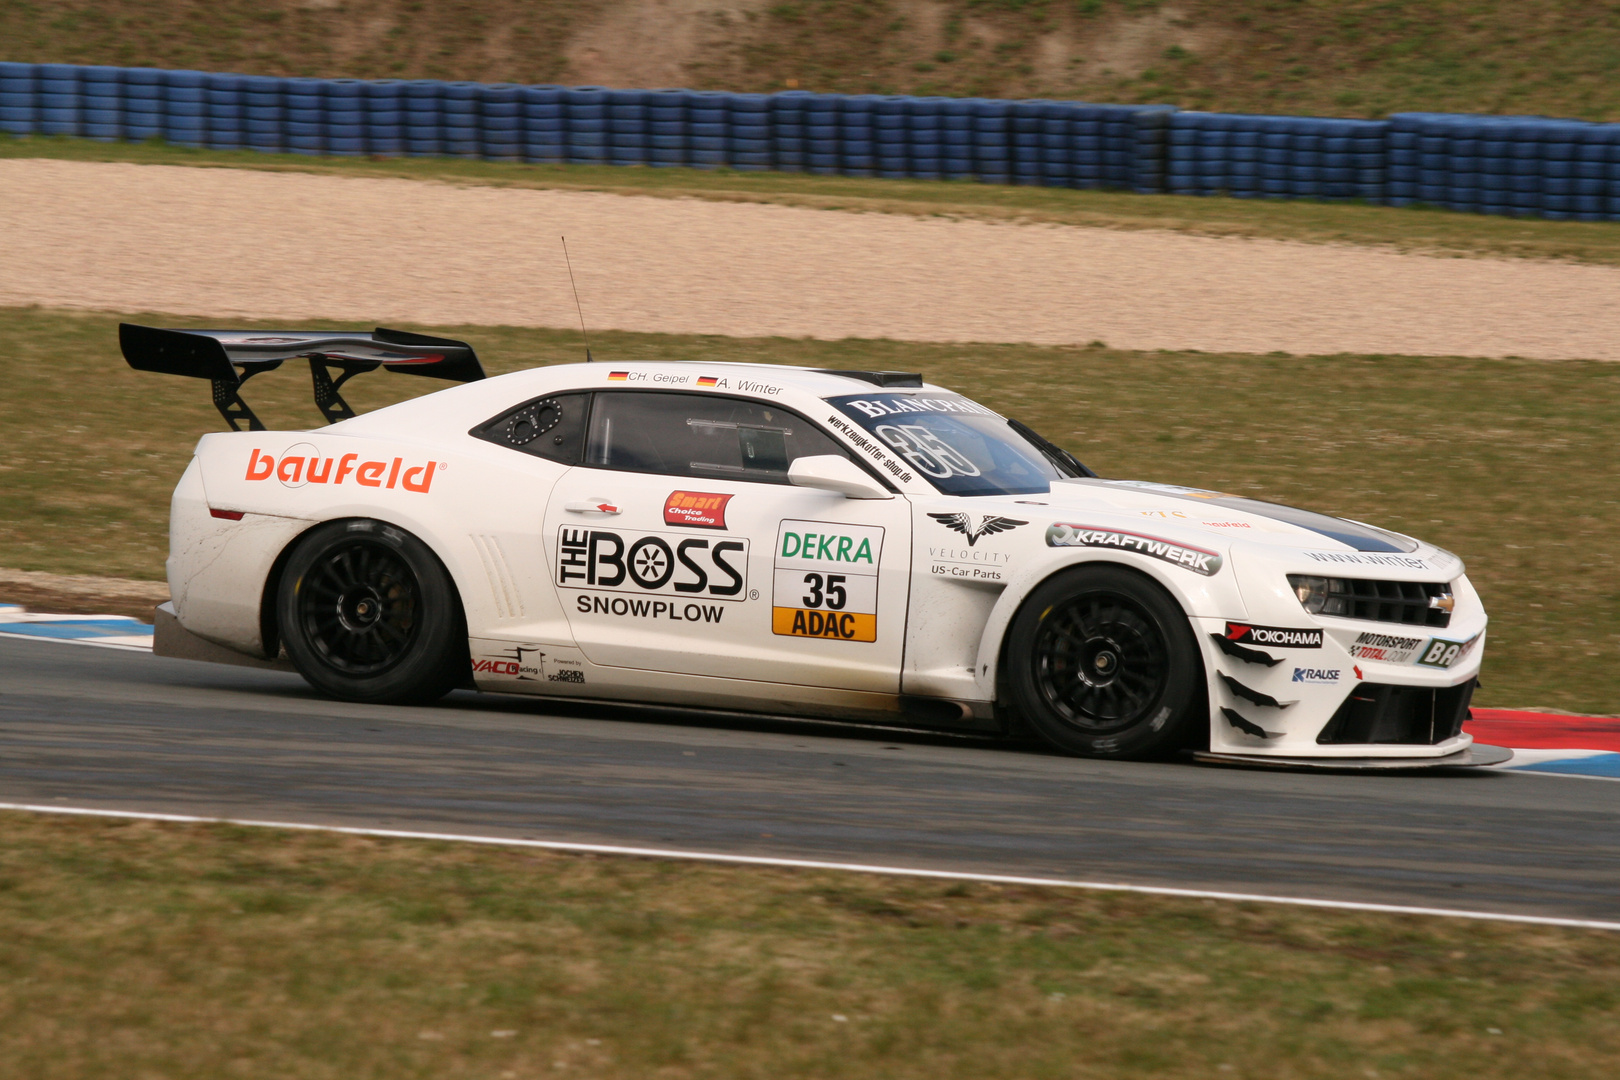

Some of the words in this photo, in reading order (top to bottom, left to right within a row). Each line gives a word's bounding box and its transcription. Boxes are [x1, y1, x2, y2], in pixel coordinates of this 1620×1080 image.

[628, 371, 648, 382] CH.
[653, 373, 690, 385] Geipel
[717, 378, 731, 389] A.
[737, 380, 783, 396] Winter
[827, 414, 912, 484] werkzeugkoffer-shop.de
[875, 424, 981, 479] 35
[244, 448, 437, 494] baufeld
[668, 506, 703, 516] Choice
[669, 492, 723, 510] Smart
[684, 515, 715, 524] Trading
[560, 528, 589, 584] THE
[781, 531, 874, 564] DEKRA
[929, 547, 1011, 563] VELOCITY
[1075, 530, 1214, 571] KRAFTWERK
[587, 530, 744, 596] BOSS
[931, 565, 970, 577] US-Car
[973, 568, 1002, 580] Parts
[802, 572, 847, 610] 35
[576, 595, 724, 624] SNOWPLOW
[791, 610, 855, 639] ADAC
[1250, 628, 1321, 645] YOKOHAMA
[1355, 632, 1422, 650] MOTORSPORT
[1292, 667, 1341, 683] KRAUSE
